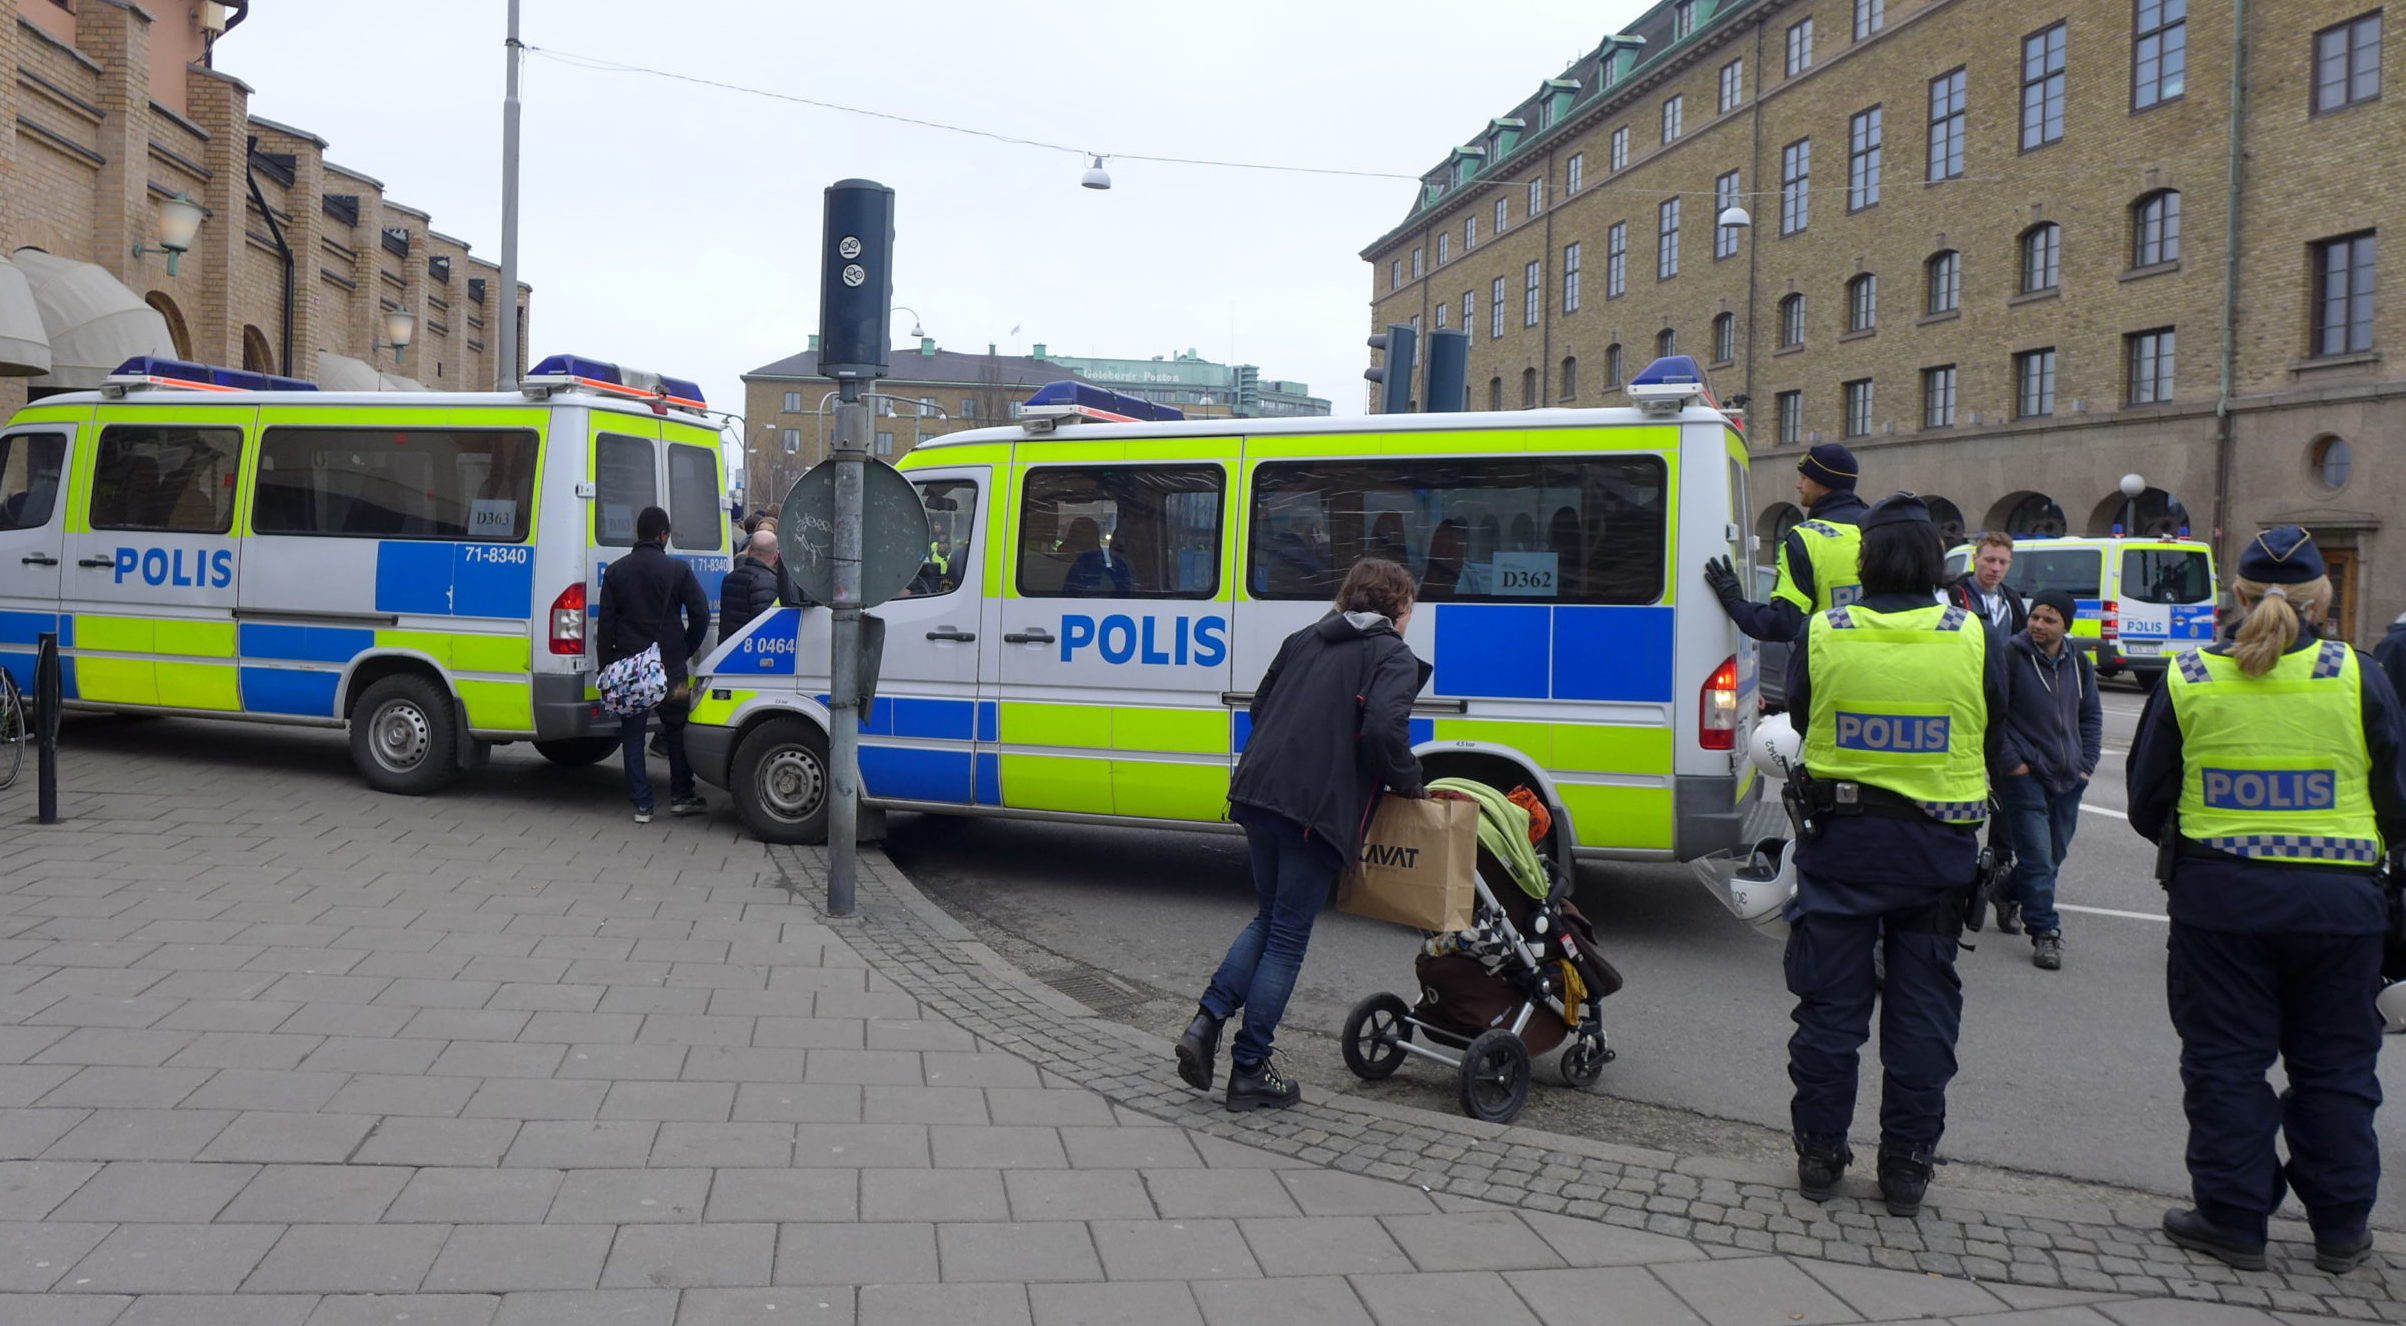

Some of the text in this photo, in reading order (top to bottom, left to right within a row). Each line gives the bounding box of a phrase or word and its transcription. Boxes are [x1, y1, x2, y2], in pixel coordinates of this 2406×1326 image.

[476, 511, 510, 526] D363
[465, 546, 527, 564] 71-8340
[115, 547, 232, 588] POLIS
[698, 558, 728, 572] 71-8340
[1503, 571, 1552, 588] D362
[2127, 621, 2162, 633] POLIS
[743, 637, 795, 654] 8 0464
[1060, 614, 1227, 668] POLIS
[1839, 715, 1946, 749] POLIS
[2206, 772, 2331, 807] POLIS
